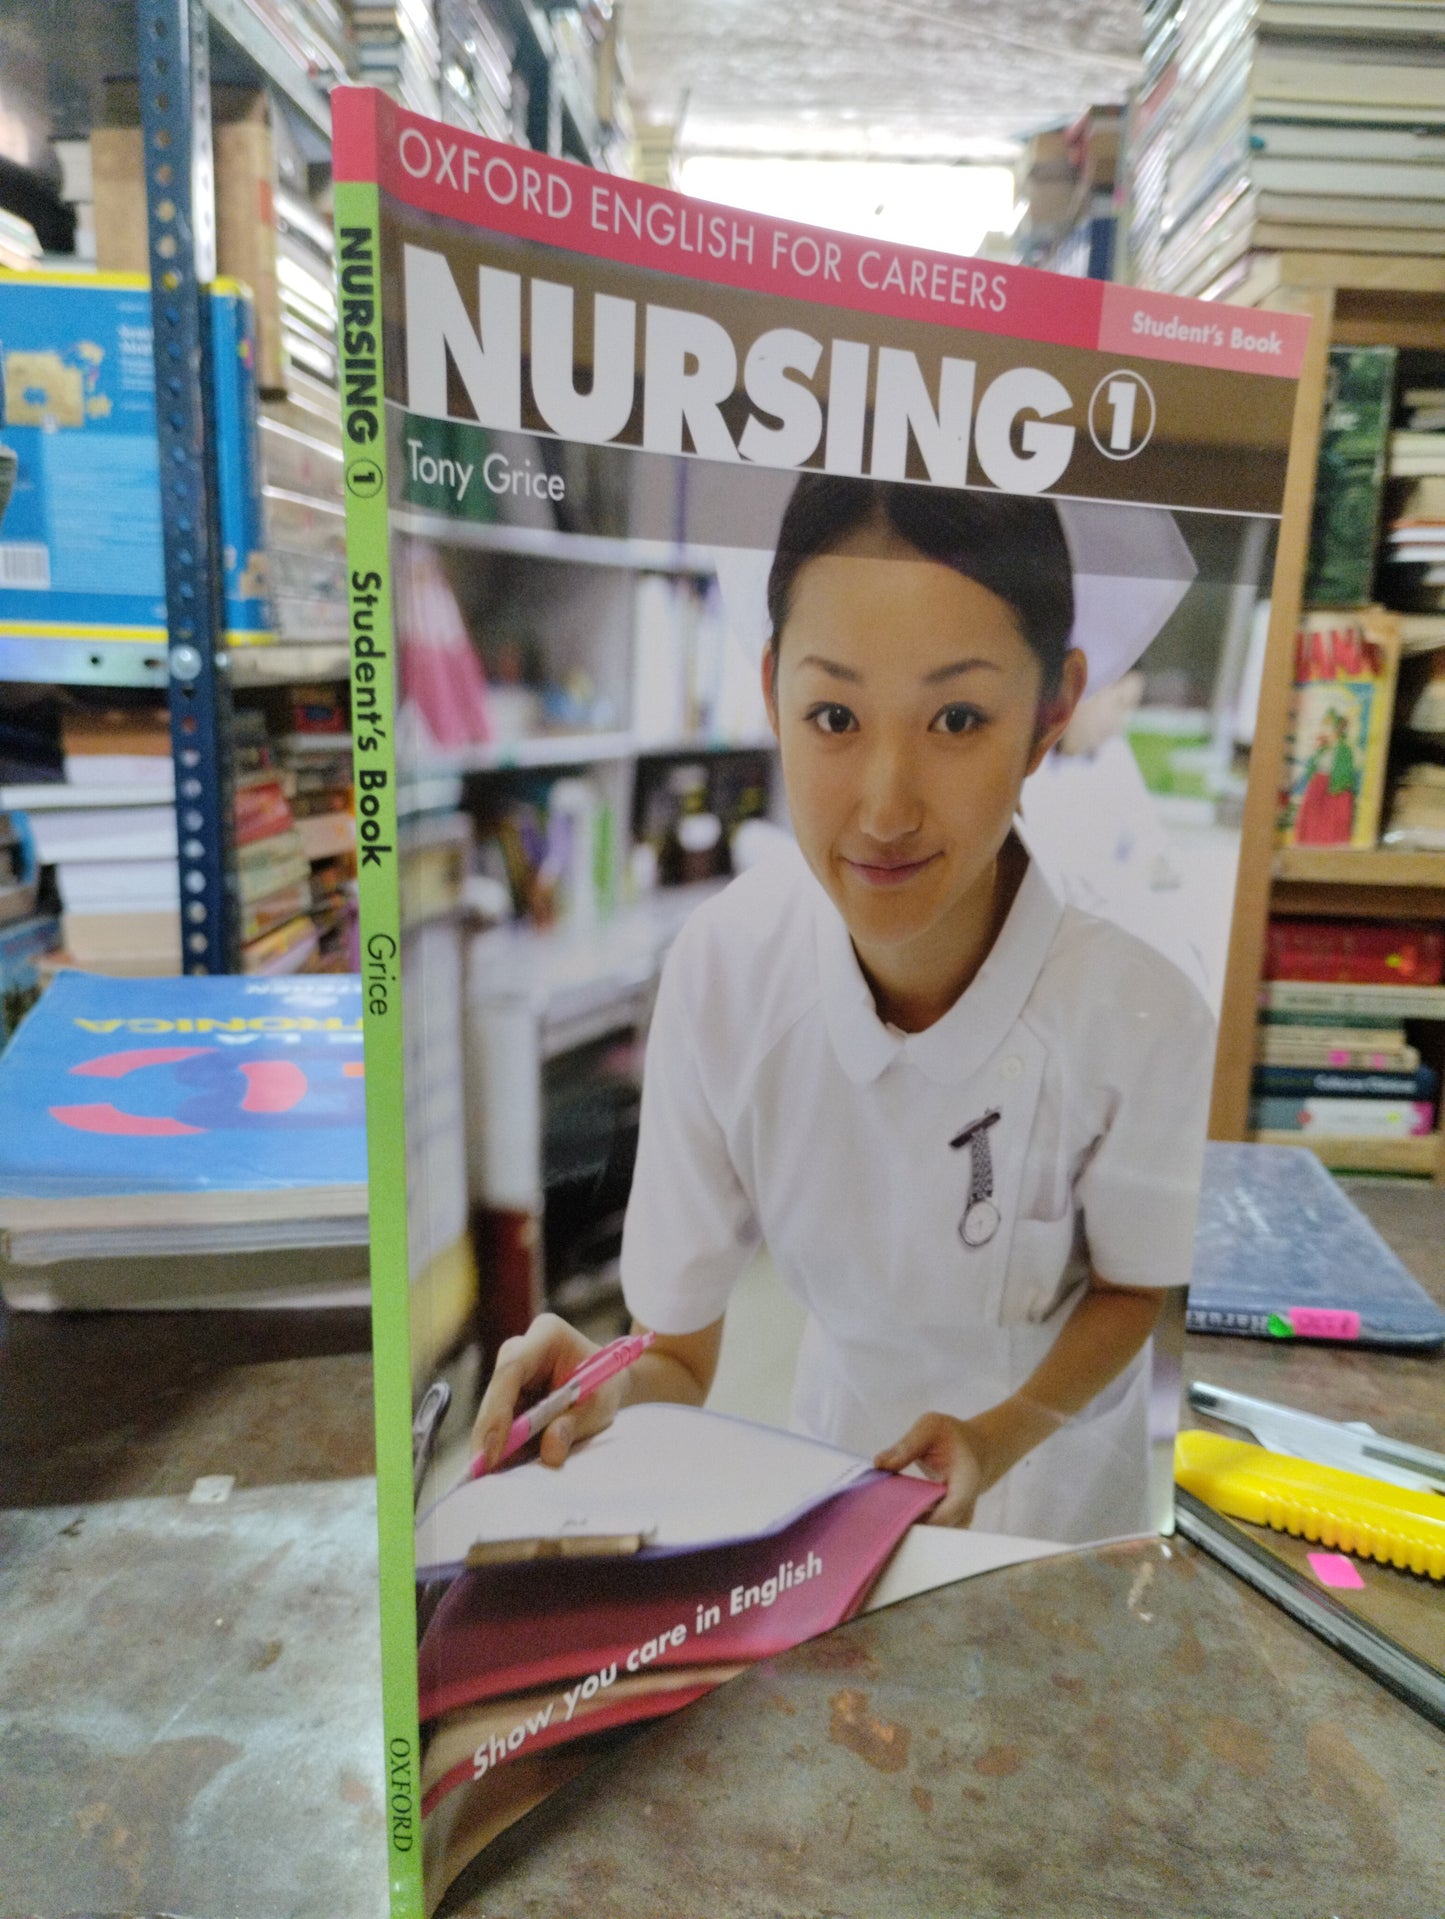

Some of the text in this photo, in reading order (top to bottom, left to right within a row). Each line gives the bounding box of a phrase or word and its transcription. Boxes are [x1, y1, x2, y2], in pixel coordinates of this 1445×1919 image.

[399, 128, 1007, 312] OXFORD ENGLISH FOR CAREERS
[339, 228, 379, 445] NURSING
[404, 243, 1076, 493] NURSING
[1132, 310, 1283, 355] Student's Book
[407, 439, 566, 501] Tony Grice
[351, 571, 392, 868] Student's Book
[367, 933, 396, 1016] Grice
[473, 1552, 823, 1780] Show you care in English
[390, 1738, 413, 1852] OXFORD
